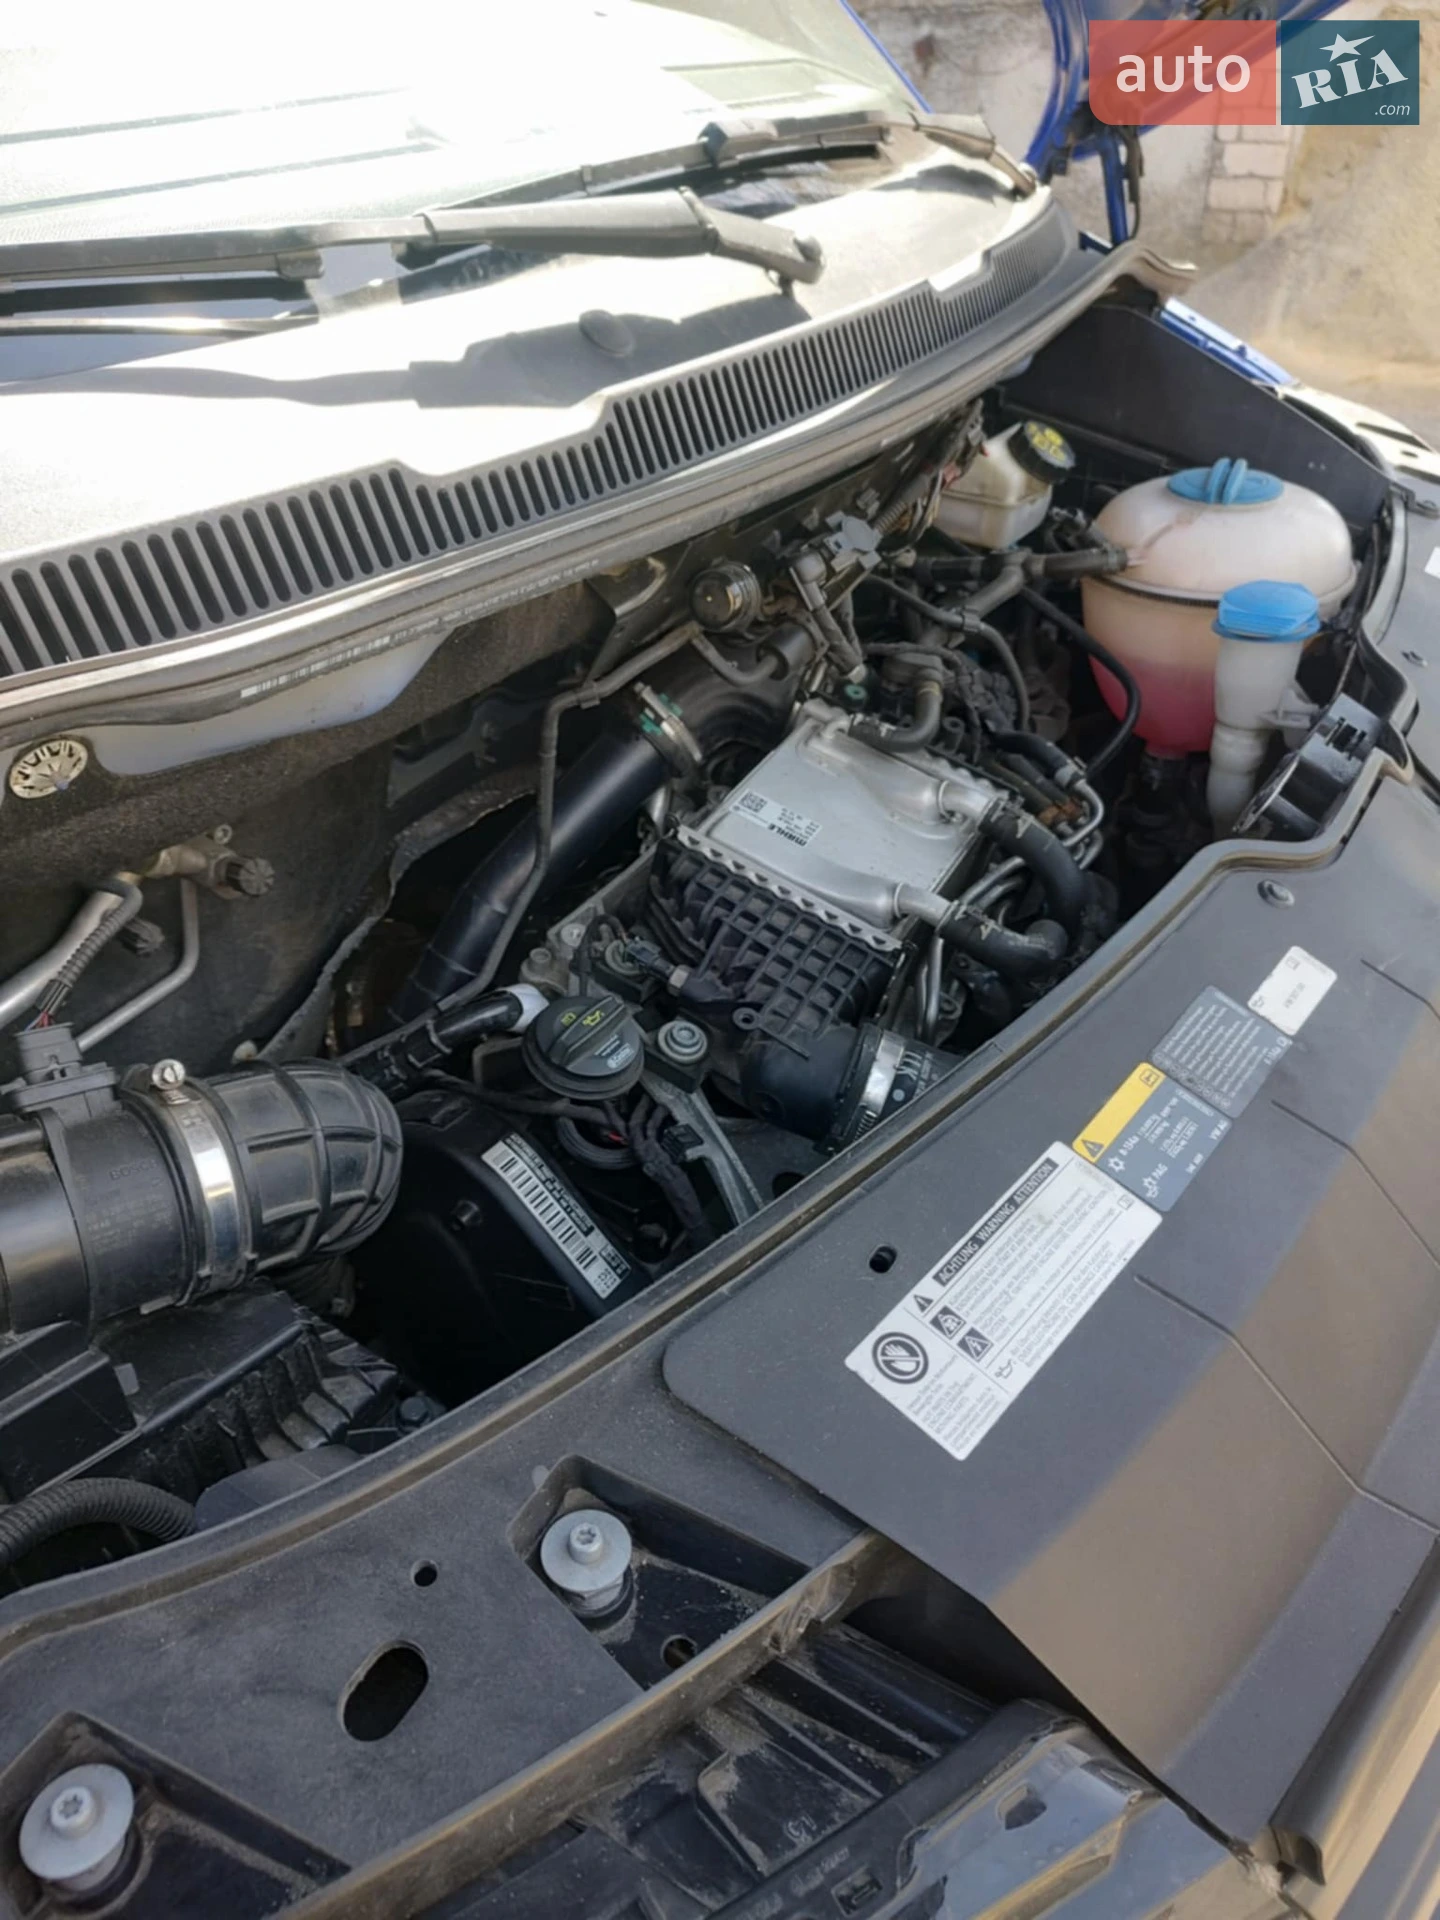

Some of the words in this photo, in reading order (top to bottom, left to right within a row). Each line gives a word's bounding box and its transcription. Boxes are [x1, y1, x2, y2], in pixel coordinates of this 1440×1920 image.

[768, 823, 807, 847] MAHLE
[109, 1159, 158, 1181] BOSCH
[938, 1240, 980, 1282] ACHTUNG
[975, 1202, 1016, 1241] WARNING
[1012, 1162, 1054, 1204] ATTENTION
